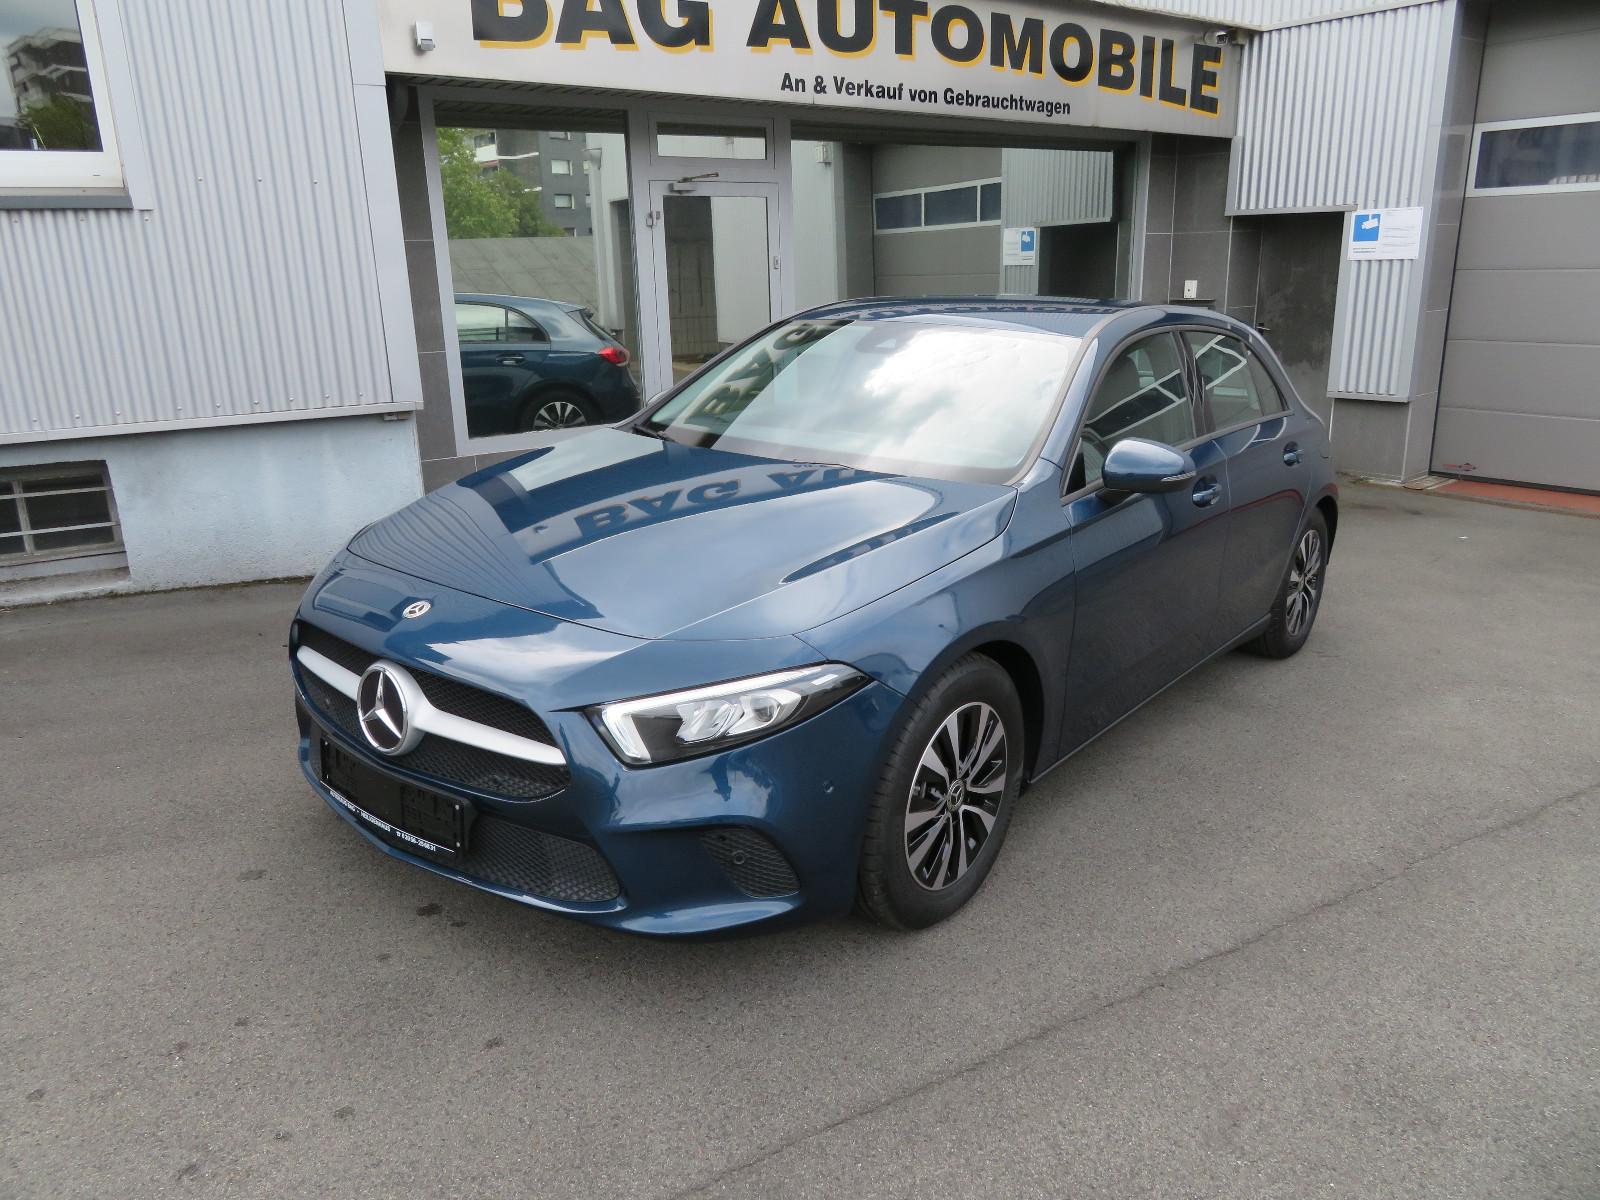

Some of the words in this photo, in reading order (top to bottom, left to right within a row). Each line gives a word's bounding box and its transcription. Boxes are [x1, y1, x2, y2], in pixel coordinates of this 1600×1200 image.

[472, 0, 713, 53] BAG
[746, 0, 1221, 117] AUTOMOBILE
[780, 72, 806, 92] An
[813, 75, 827, 94] &
[832, 75, 903, 101] Verkauf
[909, 88, 938, 103] von
[943, 87, 1071, 117] Gebrauchtwagen
